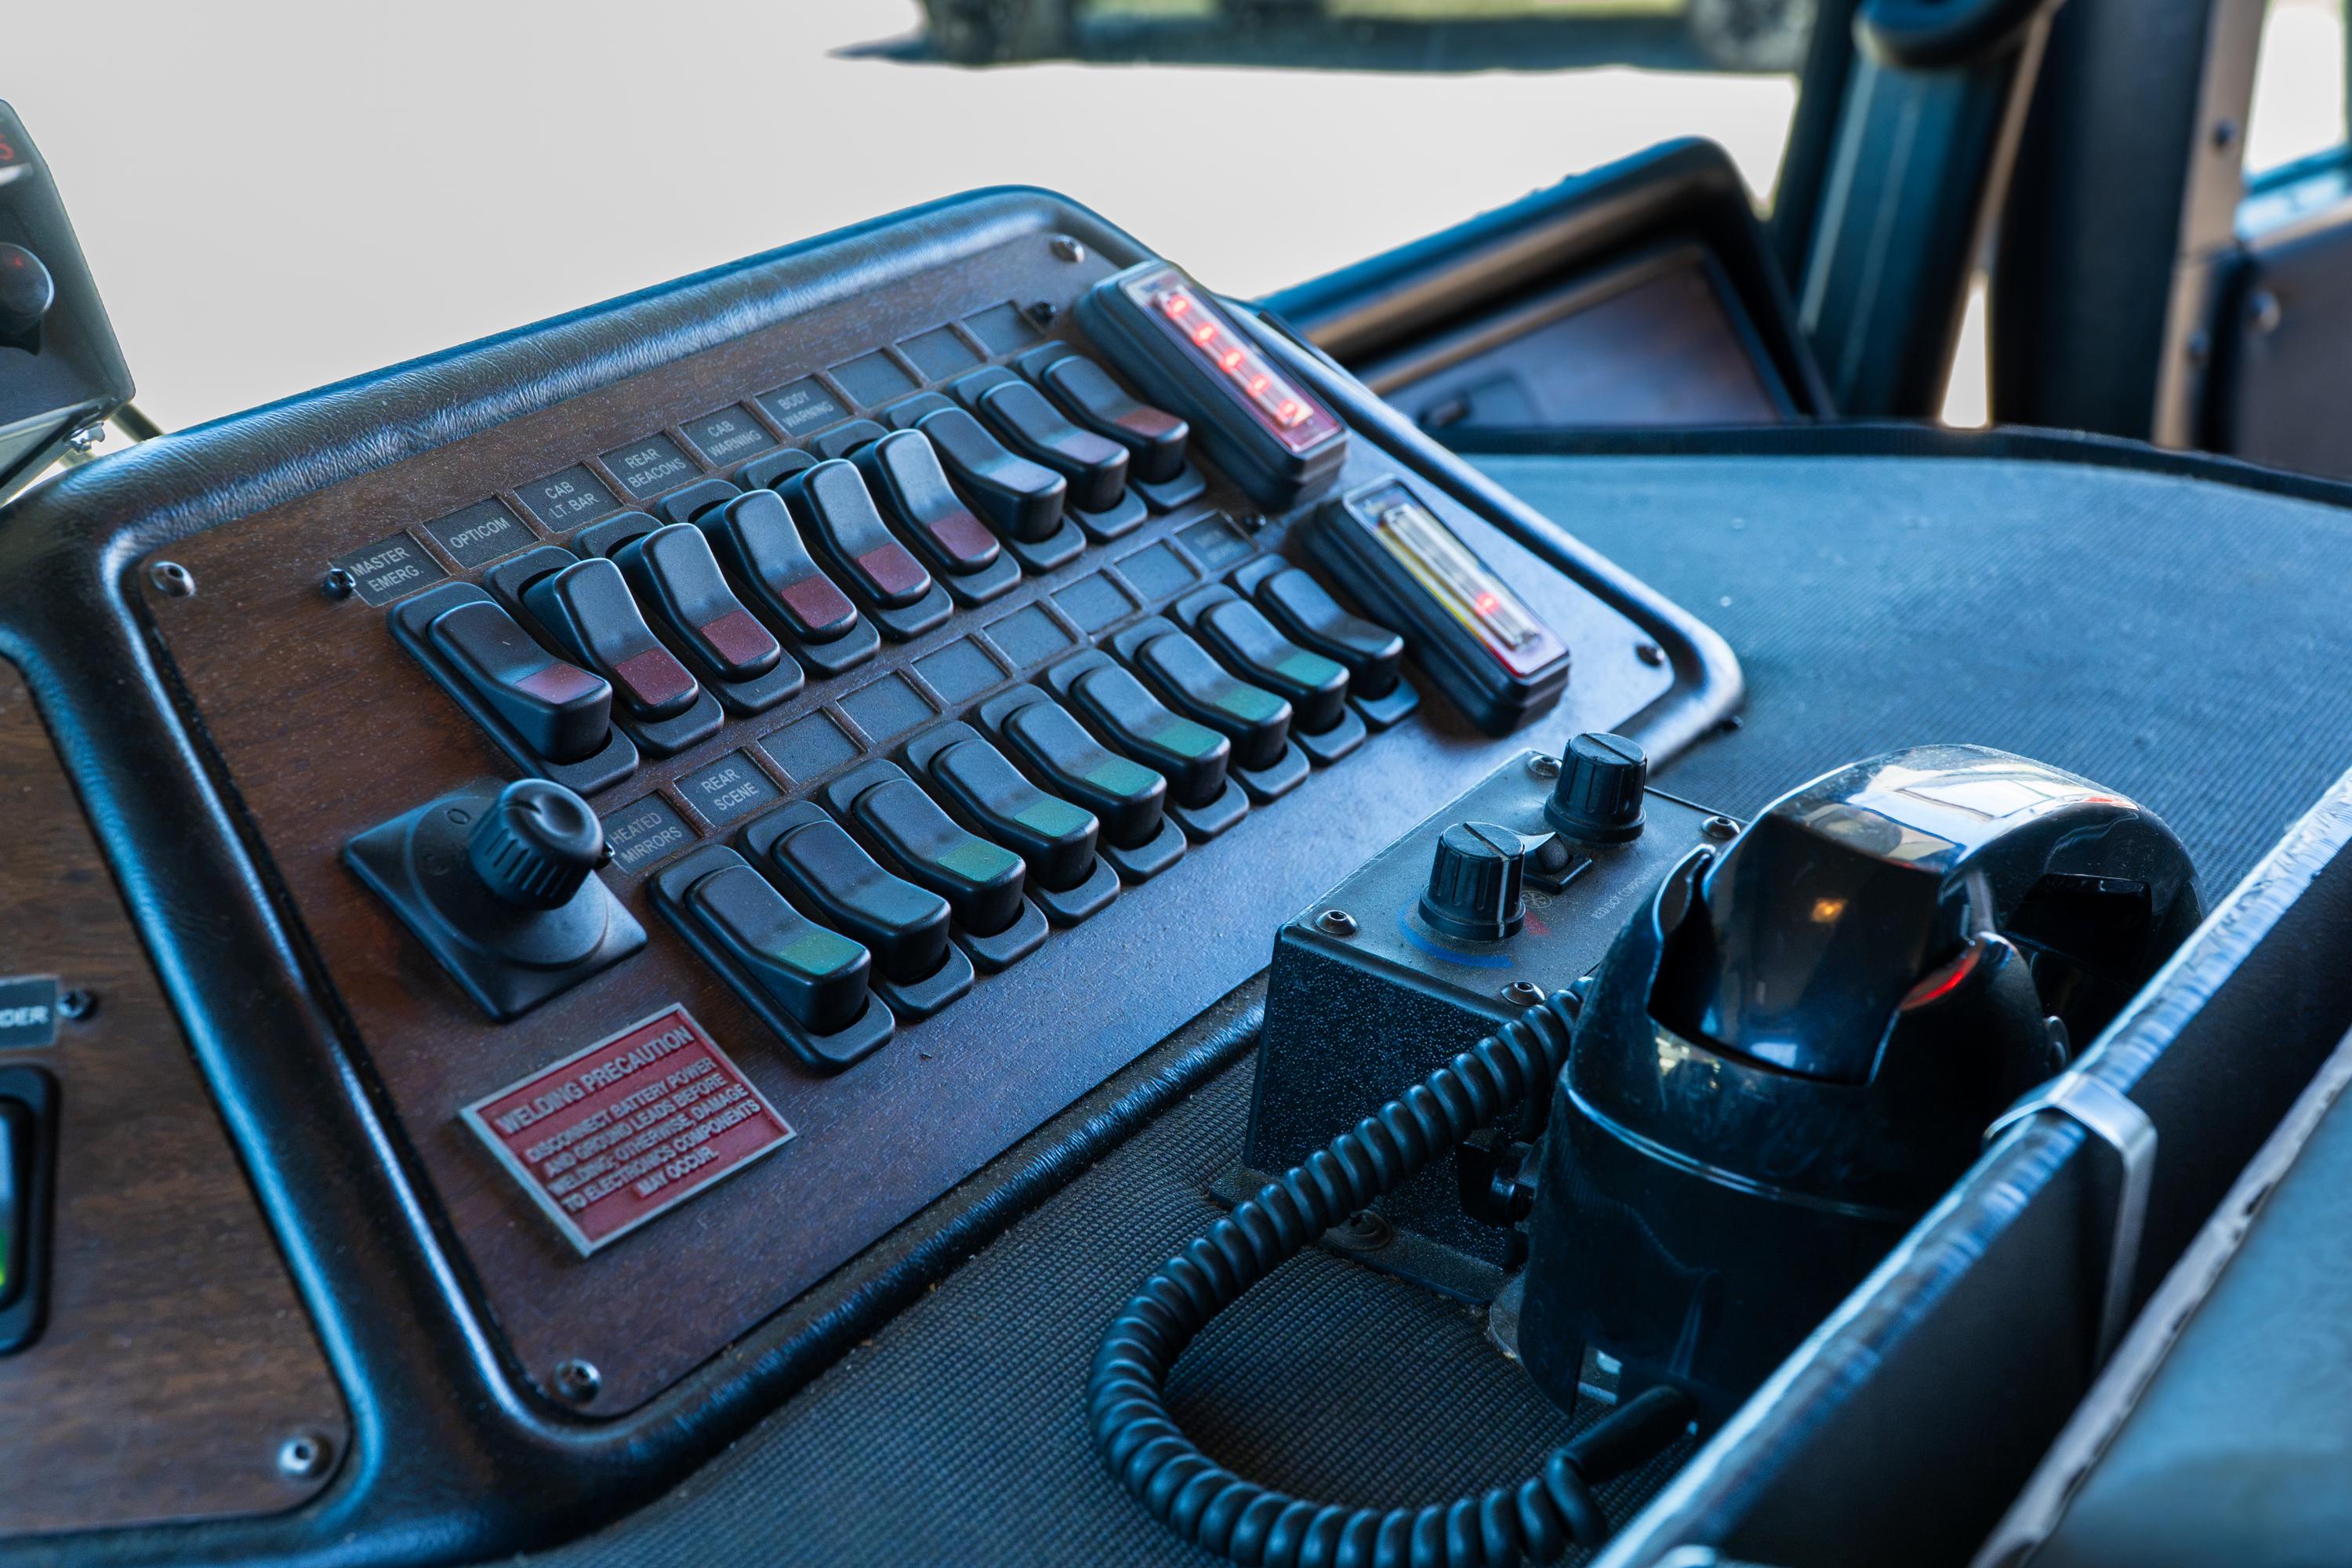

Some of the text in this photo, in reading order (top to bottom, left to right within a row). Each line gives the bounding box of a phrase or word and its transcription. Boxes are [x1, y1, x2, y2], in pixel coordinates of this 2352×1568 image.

[778, 391, 810, 411] BODY
[782, 401, 834, 428] WARNING
[707, 419, 735, 437] CAB
[625, 448, 662, 470] REAR
[707, 430, 762, 458] WARNING
[627, 458, 687, 488] BEACONS
[545, 481, 574, 499] CAB
[550, 493, 599, 520] LT. BAR
[450, 517, 511, 549] OPTICOM
[350, 547, 410, 577] MASTER
[368, 564, 424, 593] EMERG.
[701, 768, 740, 794] REAR
[714, 782, 759, 811] SCENE
[609, 812, 662, 845] HEATED
[620, 826, 682, 863] MIRRORS
[495, 1025, 694, 1134] WELDING PRECAUTION
[526, 1057, 717, 1163] DISCONNECT BATTERY POWER
[545, 1073, 728, 1177] AND GROUND LEADS BEFORE
[615, 1112, 696, 1160] OTHERWISE,
[690, 1083, 748, 1120] DAMAGE
[561, 1098, 761, 1210] TO ELECTRONICS COMPONENTS
[636, 1146, 719, 1198] MAY OCCUR.
